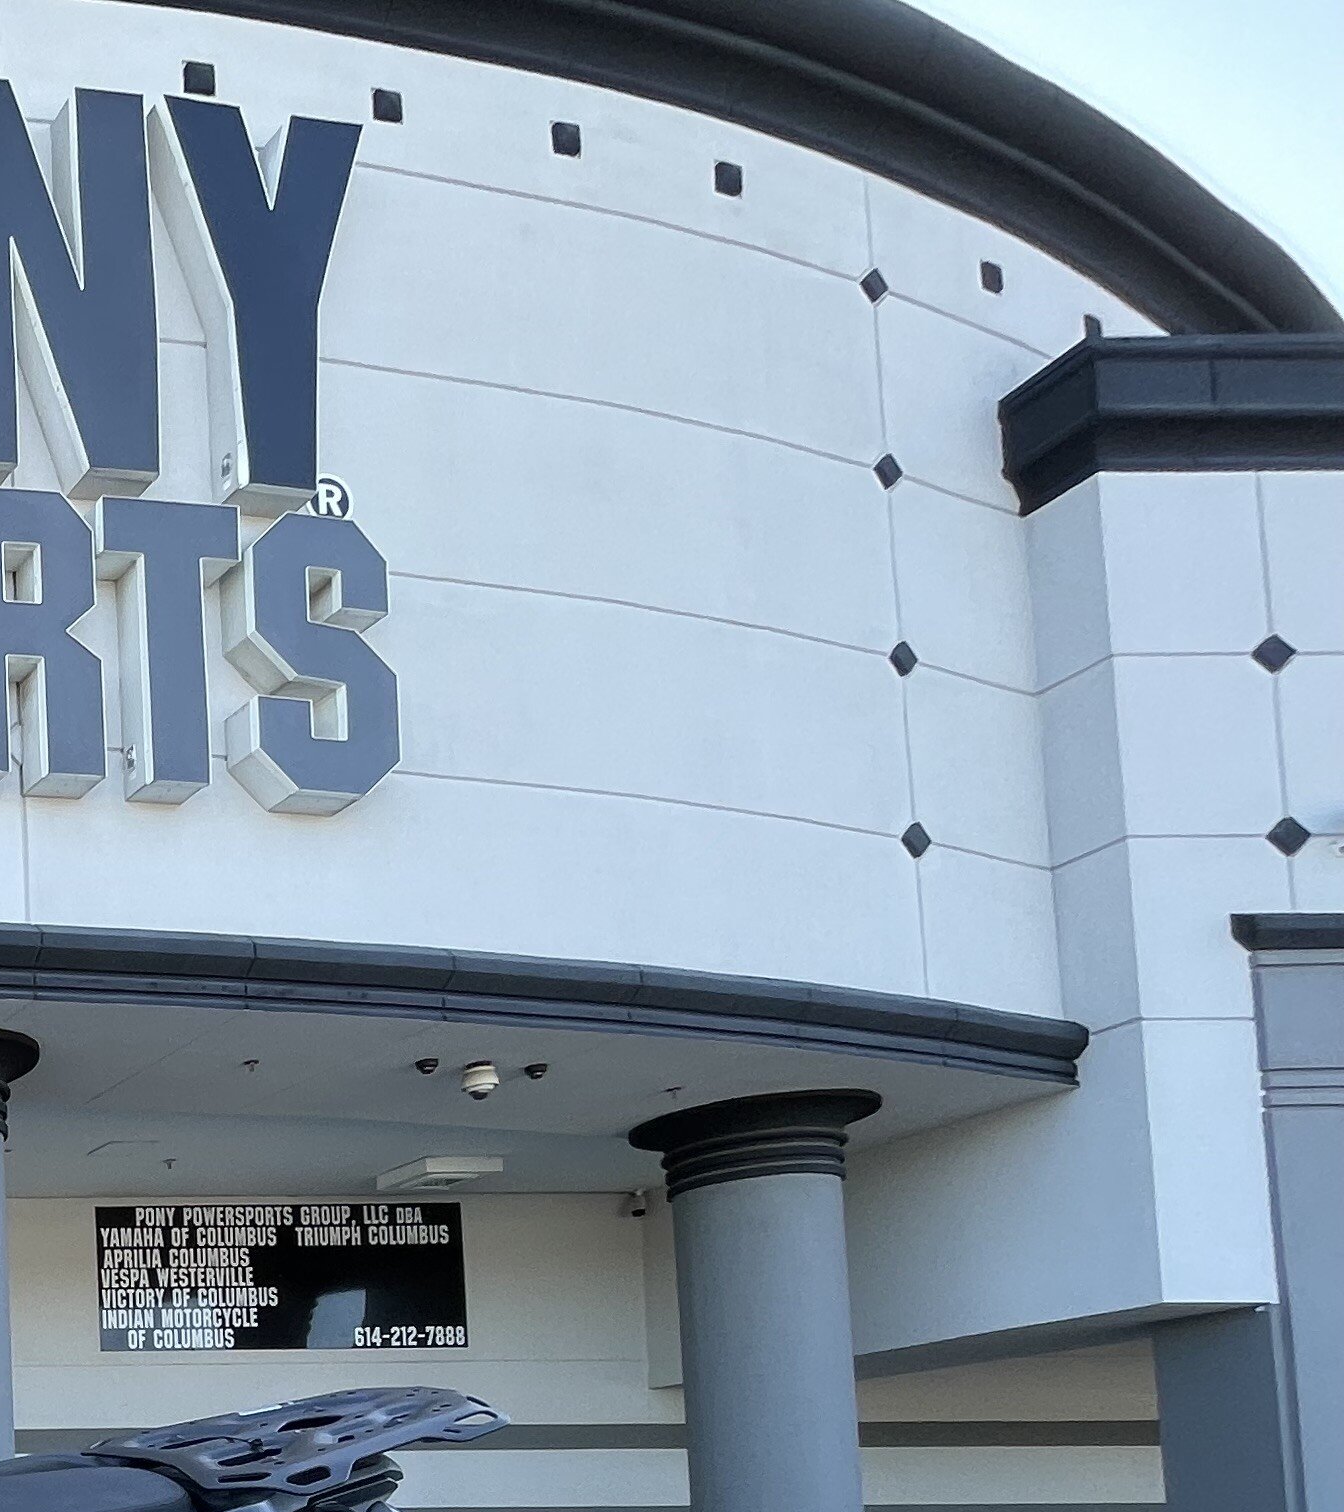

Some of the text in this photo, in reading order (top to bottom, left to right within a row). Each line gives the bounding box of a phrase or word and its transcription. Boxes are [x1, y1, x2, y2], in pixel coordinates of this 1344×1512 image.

[135, 1208, 174, 1226] PONY
[183, 1206, 292, 1225] POWERSPORTS
[364, 1205, 388, 1224] LLC
[396, 1207, 423, 1223] DBA
[100, 1227, 277, 1247] YAMAHA OF COLUMBUS
[295, 1226, 449, 1246] TRIUMPH COLUMBUS
[103, 1248, 249, 1267] APRILIA COLUMBUS
[101, 1267, 253, 1288] VESPA WESTERVILLE
[102, 1288, 278, 1308] VICTORY OF COLUMBUS
[102, 1308, 258, 1328] INDIAN MOTORCYCLE
[128, 1329, 234, 1349] OF COLUMBUS
[354, 1327, 465, 1346] 614-212-7888
